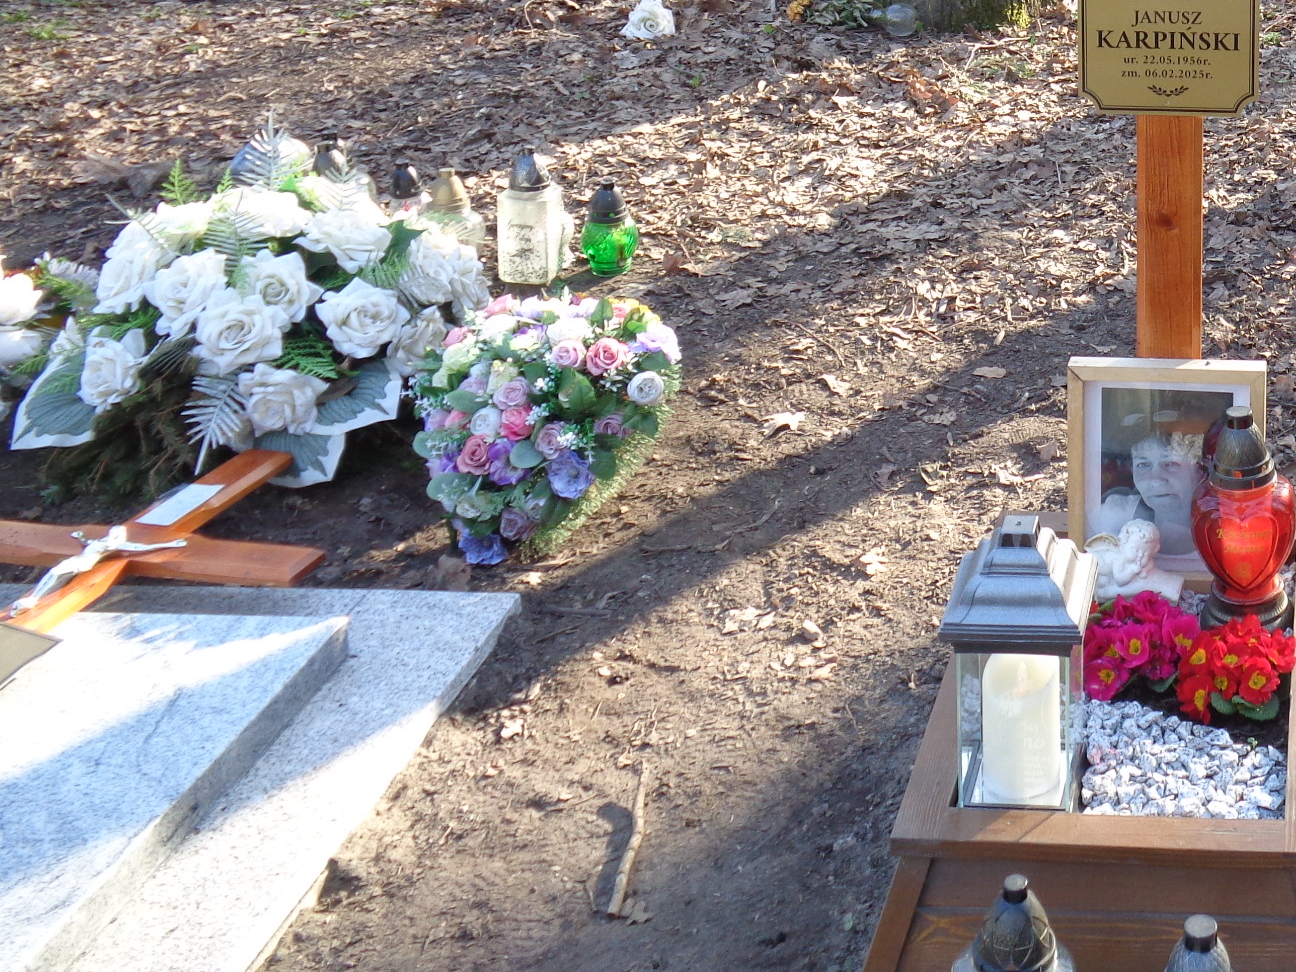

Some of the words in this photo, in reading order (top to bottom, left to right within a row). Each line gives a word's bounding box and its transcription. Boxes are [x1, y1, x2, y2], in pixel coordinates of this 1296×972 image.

[1131, 10, 1203, 27] JANUSZ
[1096, 26, 1241, 51] KARPIŃSKI
[1123, 57, 1139, 65] ur.
[1142, 55, 1211, 66] 22.05.1956r.
[1144, 69, 1213, 80] 06.02.2025r.
